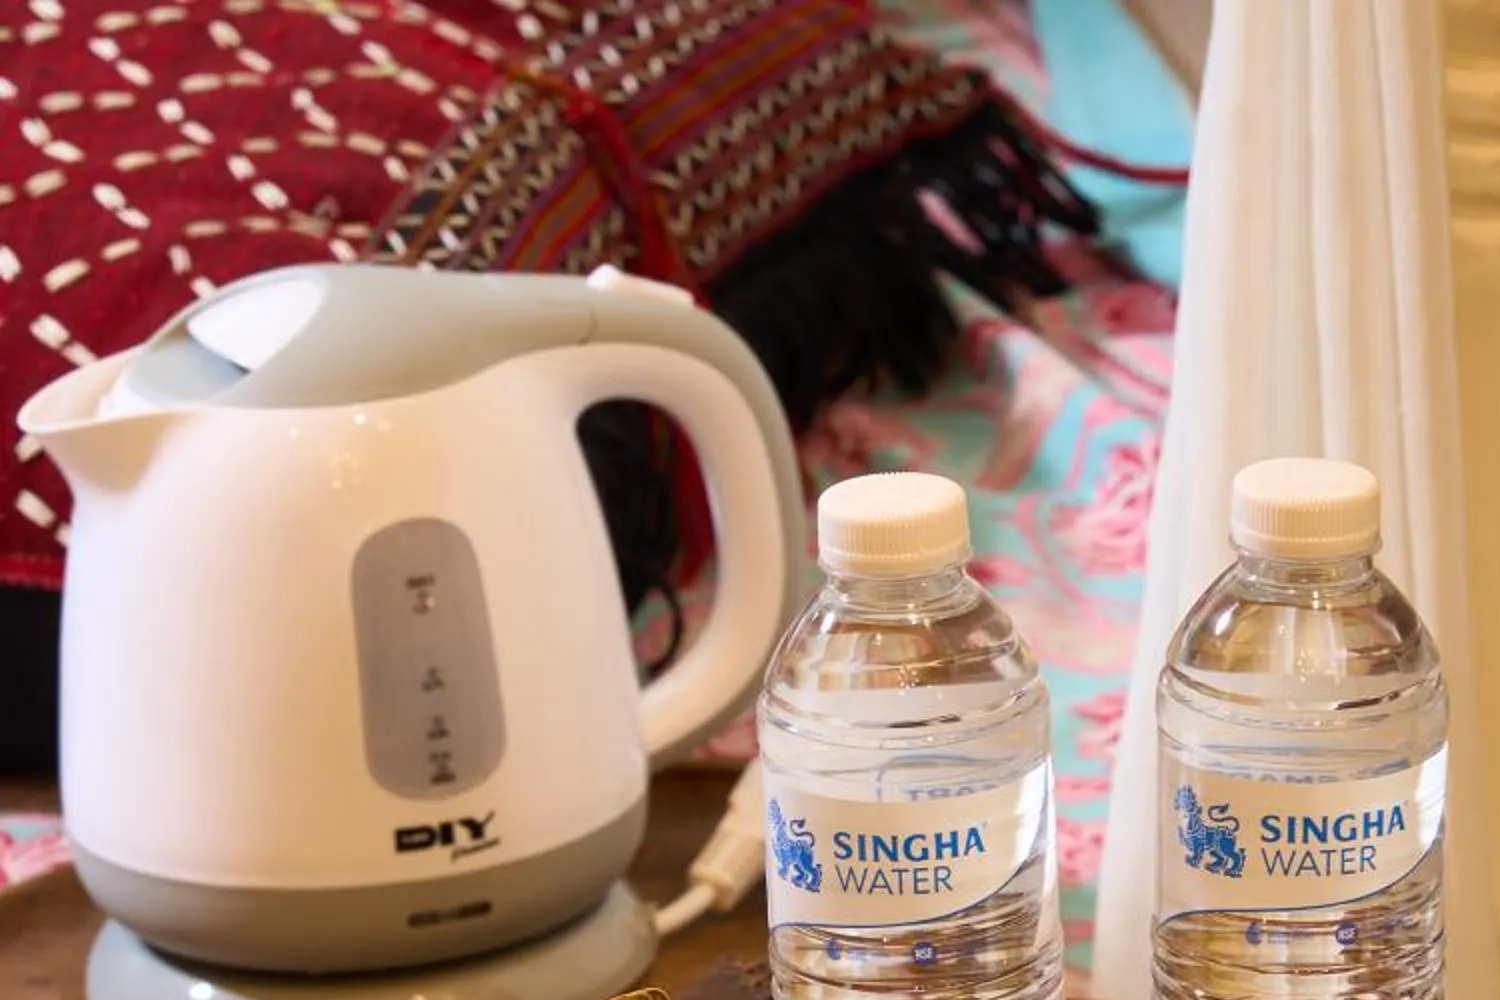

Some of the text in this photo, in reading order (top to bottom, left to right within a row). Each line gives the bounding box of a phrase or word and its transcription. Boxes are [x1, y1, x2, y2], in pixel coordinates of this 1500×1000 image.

[394, 809, 496, 853] DIY
[1260, 805, 1406, 844] SINGHA
[833, 826, 986, 862] SINGHA
[1260, 845, 1378, 877] WATER
[835, 865, 953, 895] WATER
